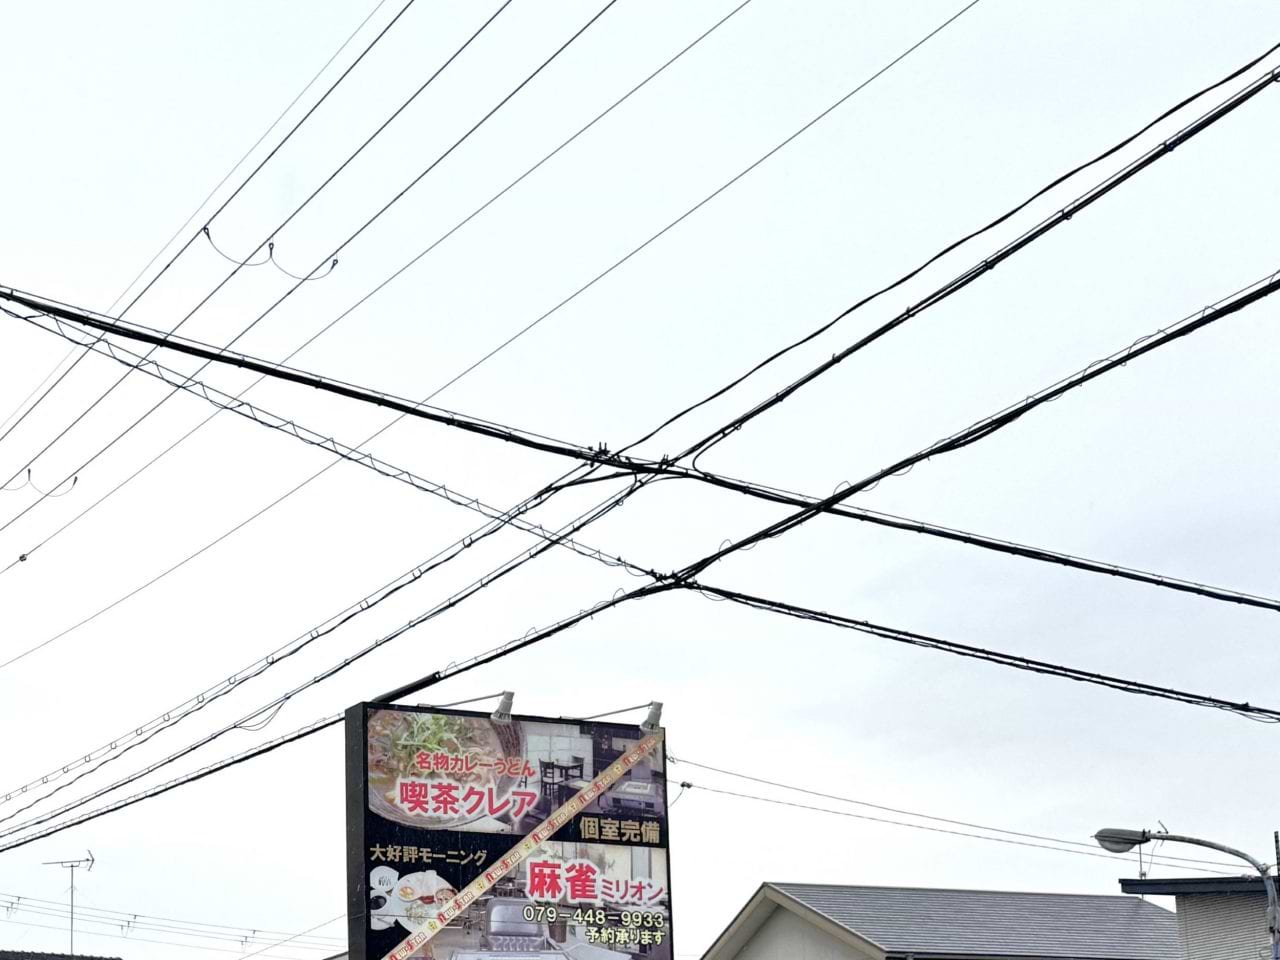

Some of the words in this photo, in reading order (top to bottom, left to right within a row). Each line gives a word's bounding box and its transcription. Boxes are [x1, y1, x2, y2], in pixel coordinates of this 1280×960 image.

[414, 750, 536, 778] 名物カレーうどん
[399, 781, 538, 818] 喫茶クレア
[579, 817, 661, 845] 個室完備
[369, 844, 488, 866] 大好評モーニング
[585, 928, 666, 945] 予約承ります
